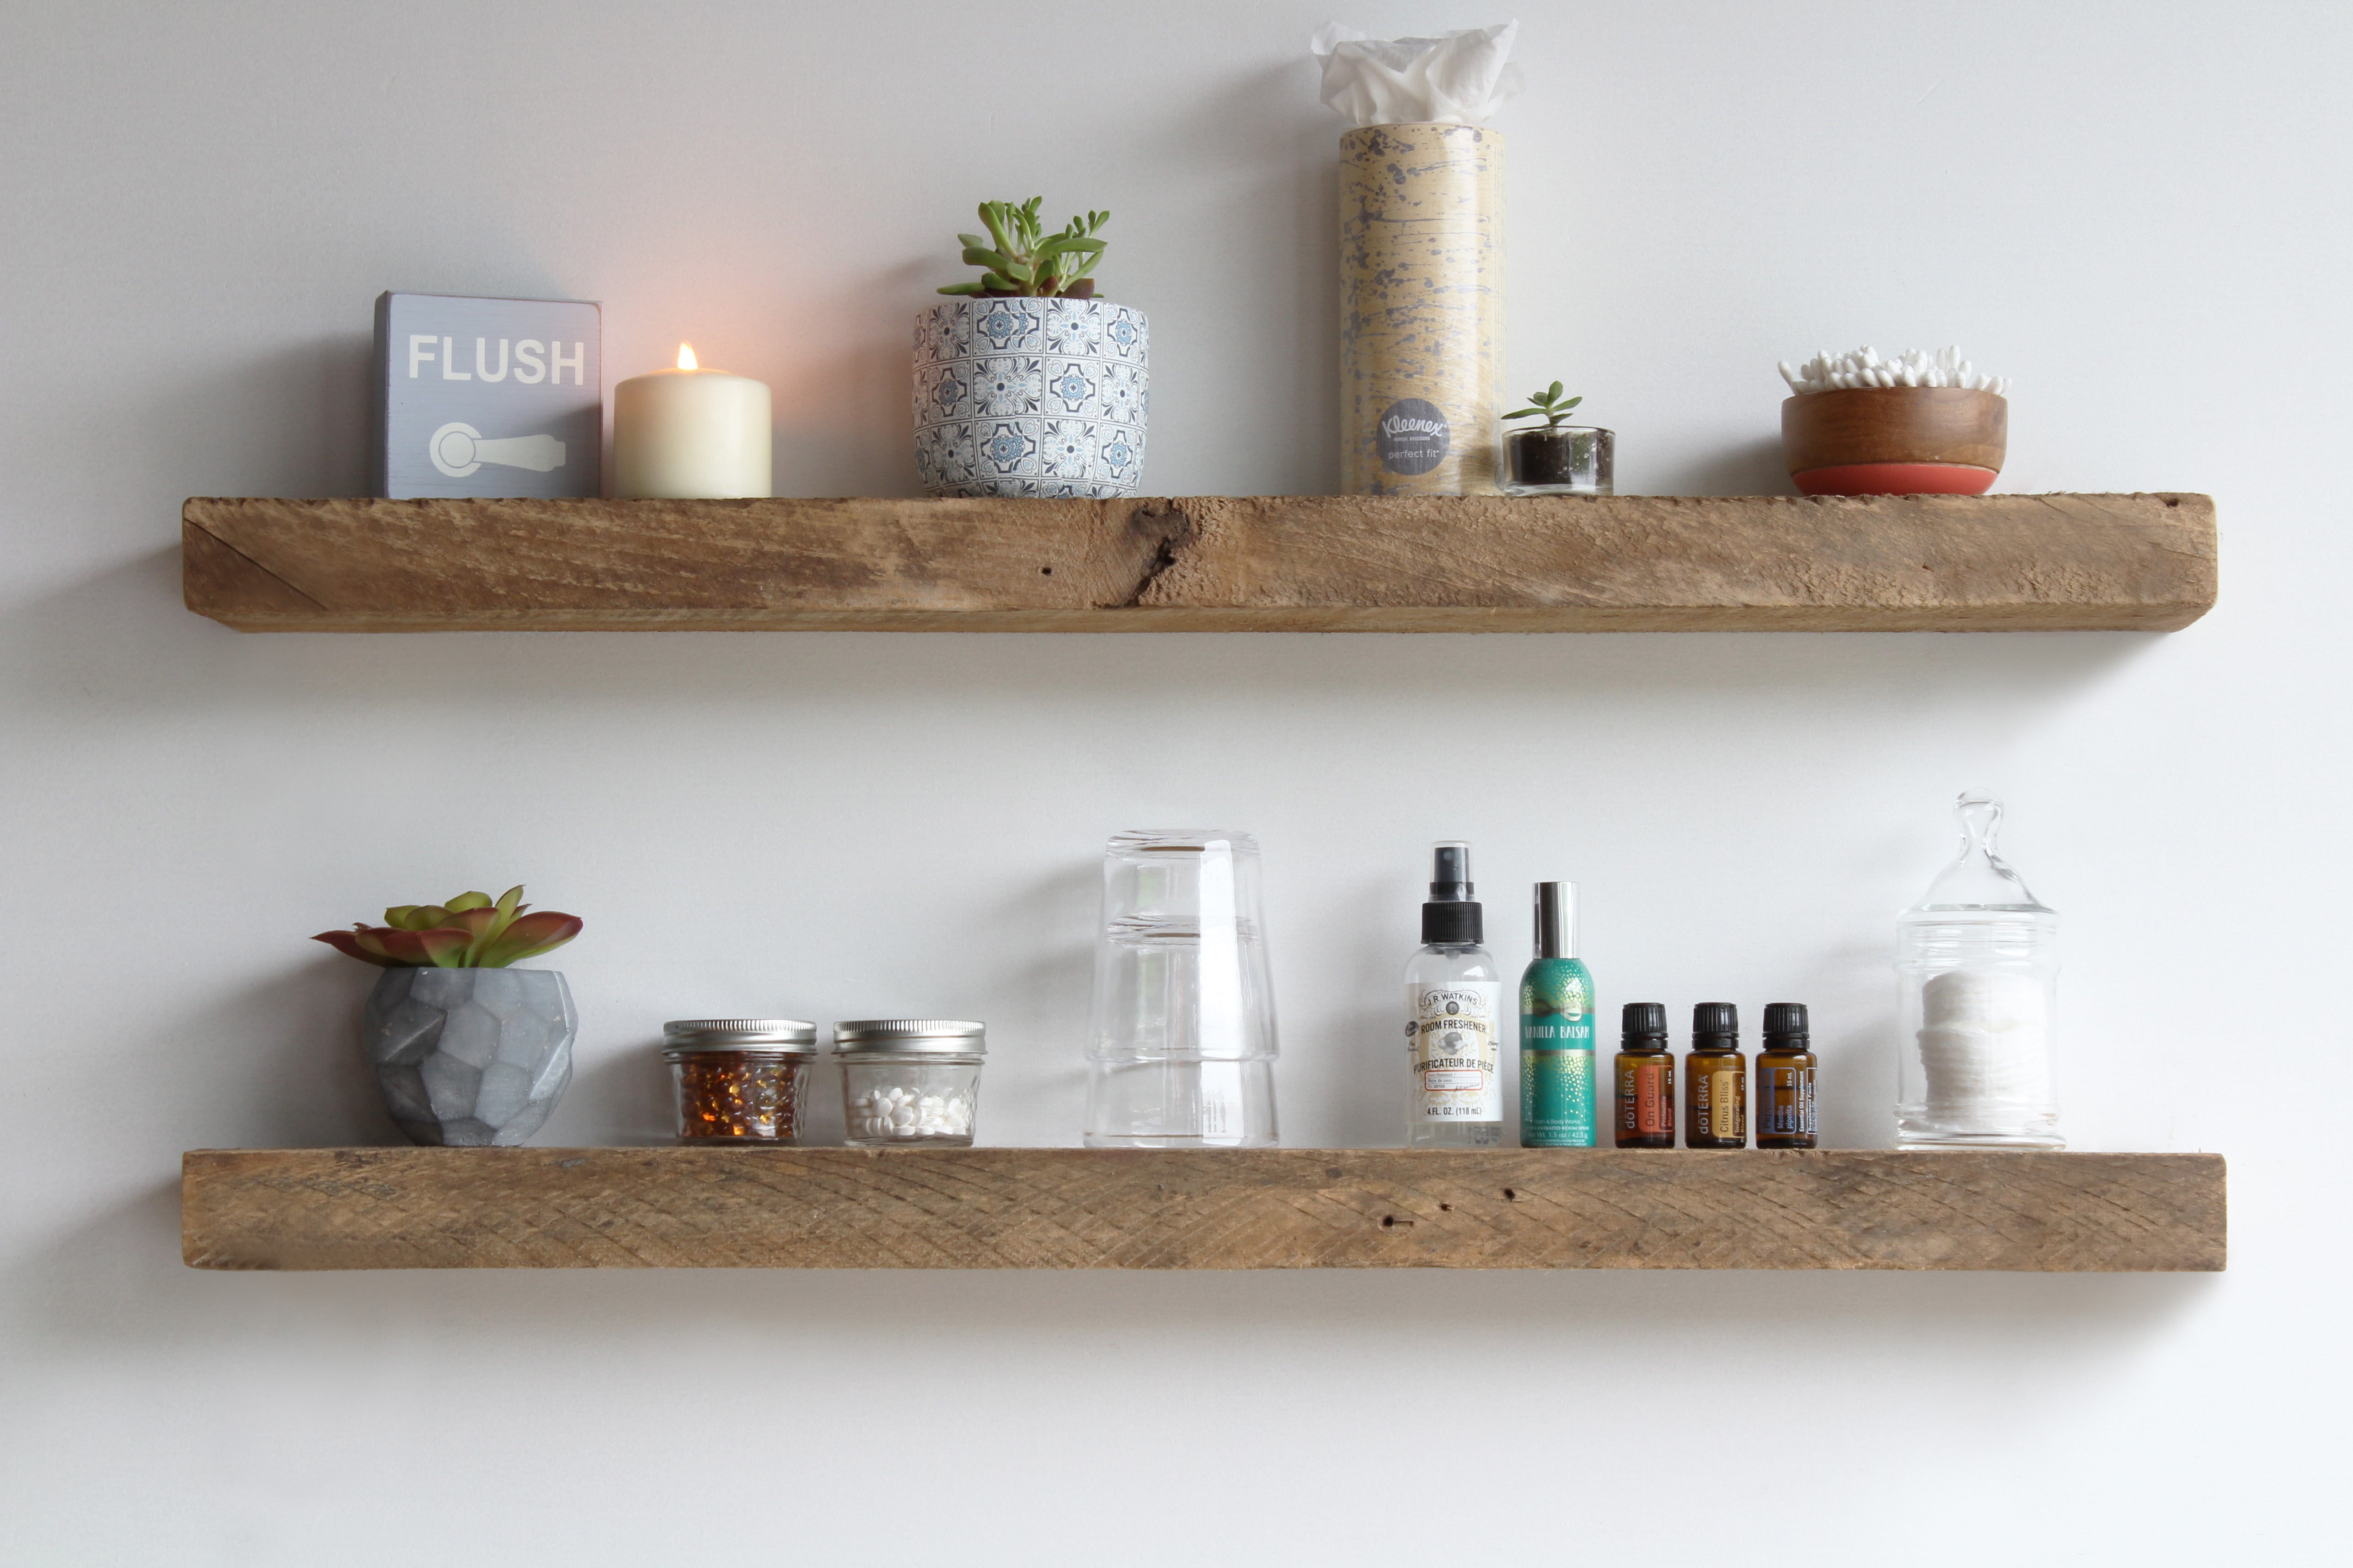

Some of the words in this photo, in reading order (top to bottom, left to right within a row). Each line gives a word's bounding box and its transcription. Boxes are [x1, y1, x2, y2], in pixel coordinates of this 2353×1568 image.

[408, 334, 584, 385] FLUSH
[1382, 415, 1444, 438] Kleenex
[1388, 449, 1423, 460] perfect
[1427, 449, 1437, 457] fit
[1428, 995, 1441, 1006] J.R.
[1441, 992, 1478, 1005] WATKINS
[1421, 1021, 1441, 1035] ROOM
[1444, 1019, 1486, 1034] FRESHENER
[1525, 1026, 1556, 1038] VANILLA
[1560, 1025, 1589, 1038] BALSAM
[1414, 1058, 1464, 1074] PURIFICATEUR
[1466, 1059, 1476, 1069] DE
[1477, 1059, 1494, 1074] PIÈCE
[1645, 1073, 1654, 1108] Guard
[1720, 1081, 1729, 1103] Bliss
[1763, 1072, 1772, 1129] Peppermint
[1432, 1107, 1441, 1115] FL.
[1456, 1107, 1469, 1116] (118
[1471, 1107, 1482, 1116] mL)
[1645, 1111, 1654, 1126] On
[1720, 1106, 1729, 1132] Citrus
[1786, 1104, 1794, 1129] piperita
